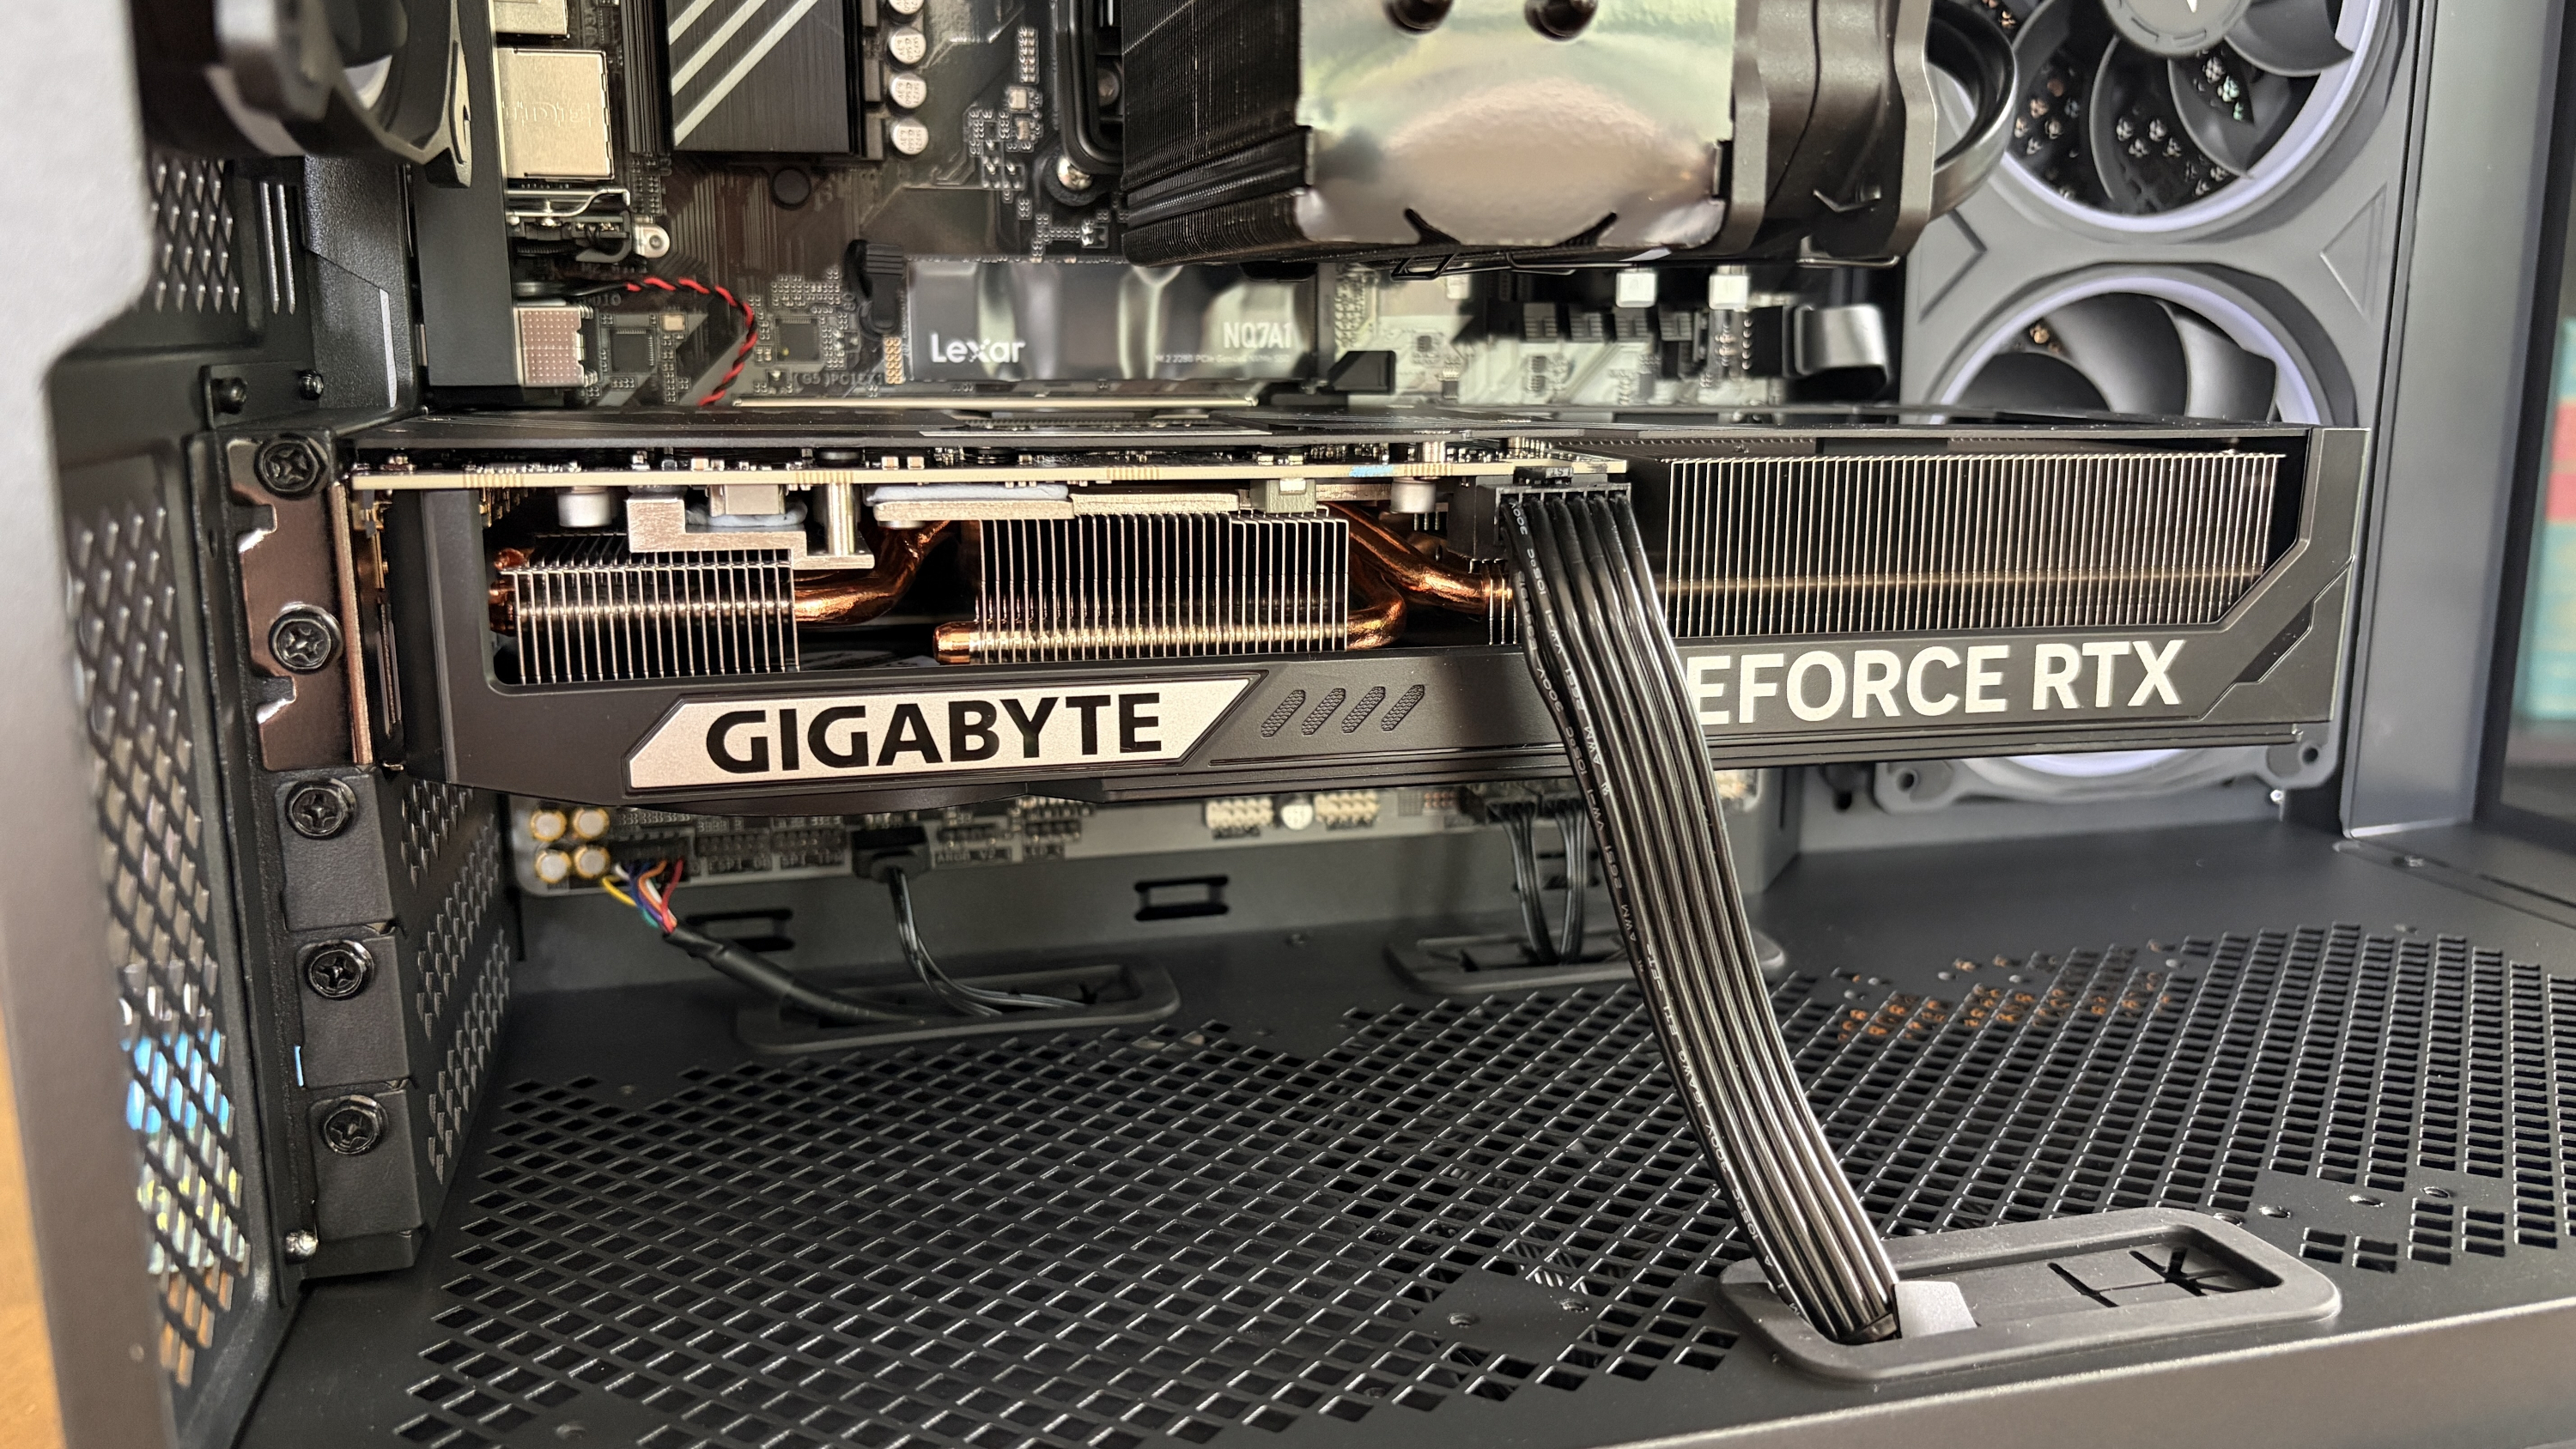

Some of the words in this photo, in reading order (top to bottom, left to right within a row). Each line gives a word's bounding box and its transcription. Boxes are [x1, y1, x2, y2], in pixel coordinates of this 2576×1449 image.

[931, 333, 1026, 363] Lexar
[1223, 322, 1293, 349] NQ7A1
[1509, 500, 1528, 536] 300V
[1546, 609, 1564, 655] VW-1
[1537, 668, 1564, 712] 300V
[1686, 644, 2009, 725] EFORCE
[2032, 640, 2187, 712] RTX
[706, 692, 1162, 773] GIGABYTE
[1583, 726, 1601, 765] AWM
[1587, 789, 1604, 831] VW-1
[1605, 846, 1623, 889] 2651
[1621, 904, 1637, 942] AWM
[1678, 1050, 1704, 1108] 16AWG
[1705, 1124, 1730, 1173] 300V
